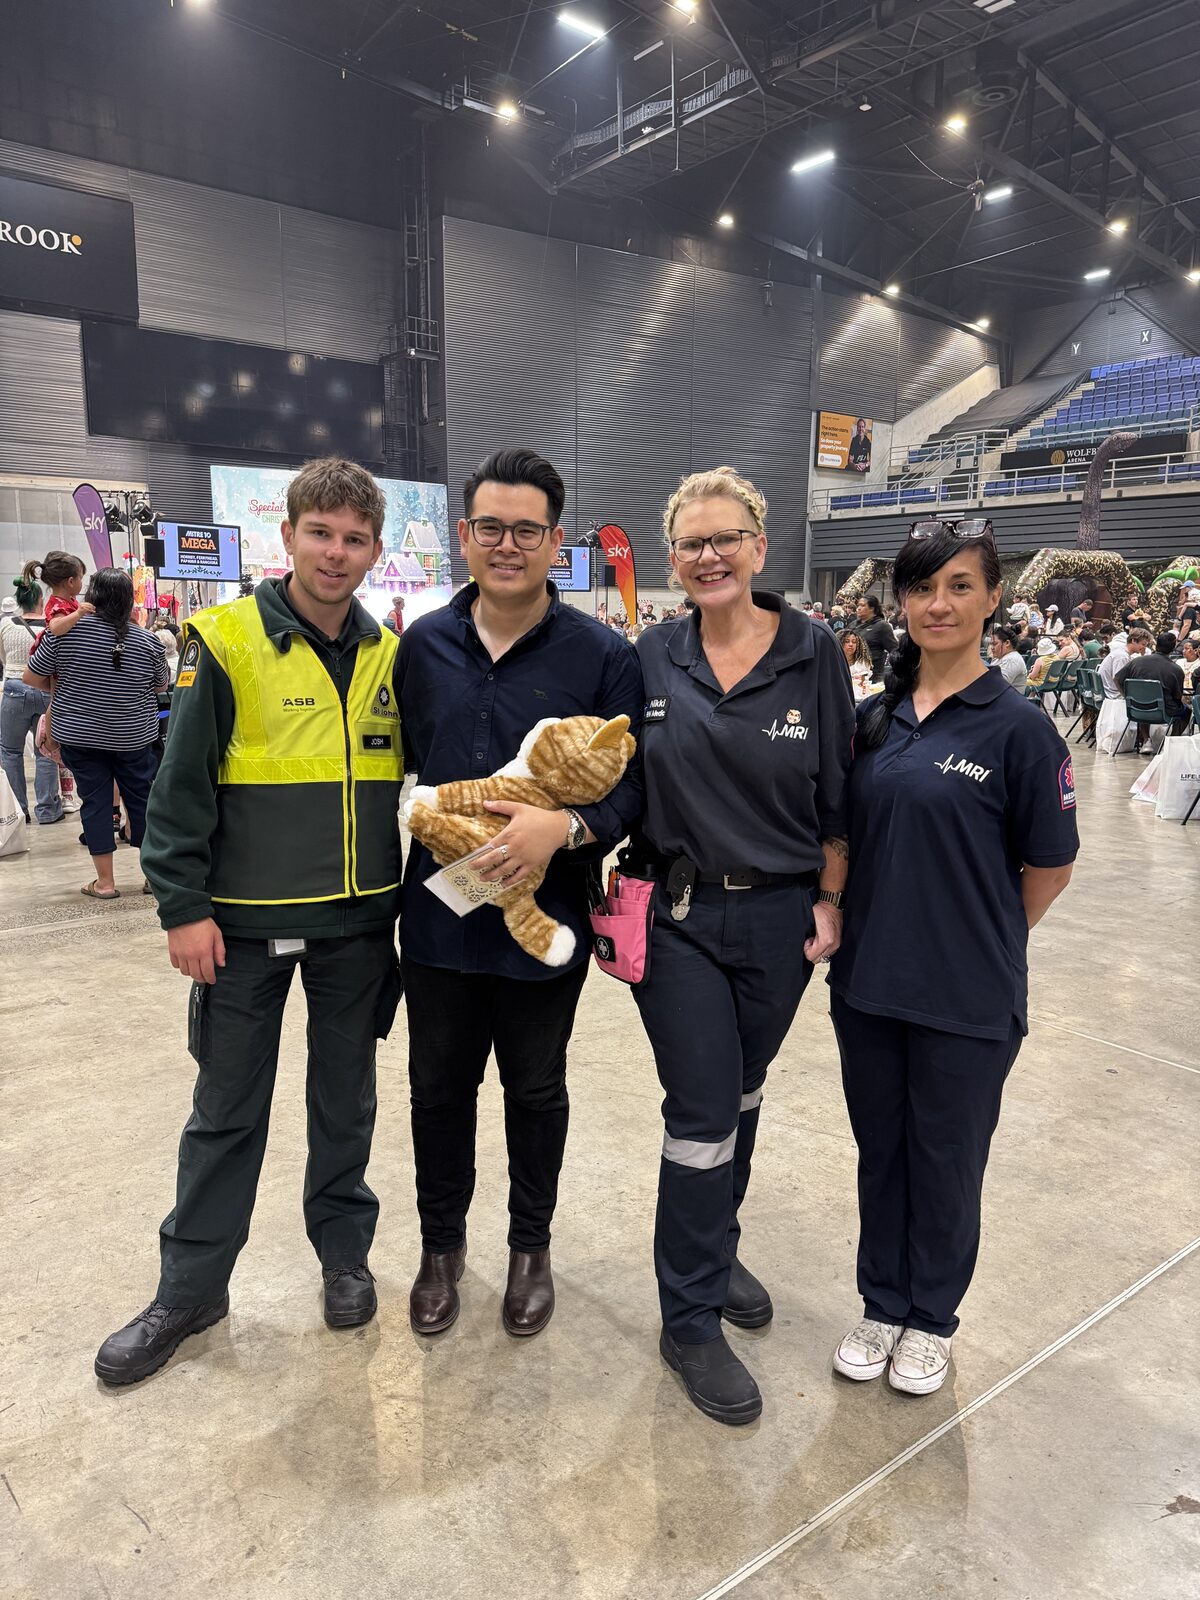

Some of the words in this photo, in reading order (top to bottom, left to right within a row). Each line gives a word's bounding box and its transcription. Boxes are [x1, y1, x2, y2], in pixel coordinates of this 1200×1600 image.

[0, 220, 82, 255] ROOK
[1142, 331, 1149, 342] X
[1073, 343, 1080, 354] Y
[1066, 447, 1099, 458] WOLFB
[249, 499, 286, 516] Special
[185, 530, 202, 538] MITRE
[180, 537, 217, 550] MEGA
[553, 557, 570, 566] GA
[650, 699, 666, 708] Nikki
[373, 706, 380, 714] St
[381, 708, 398, 718] John
[781, 724, 809, 740] MRI
[371, 737, 384, 746] JOSH
[957, 758, 991, 783] MRI
